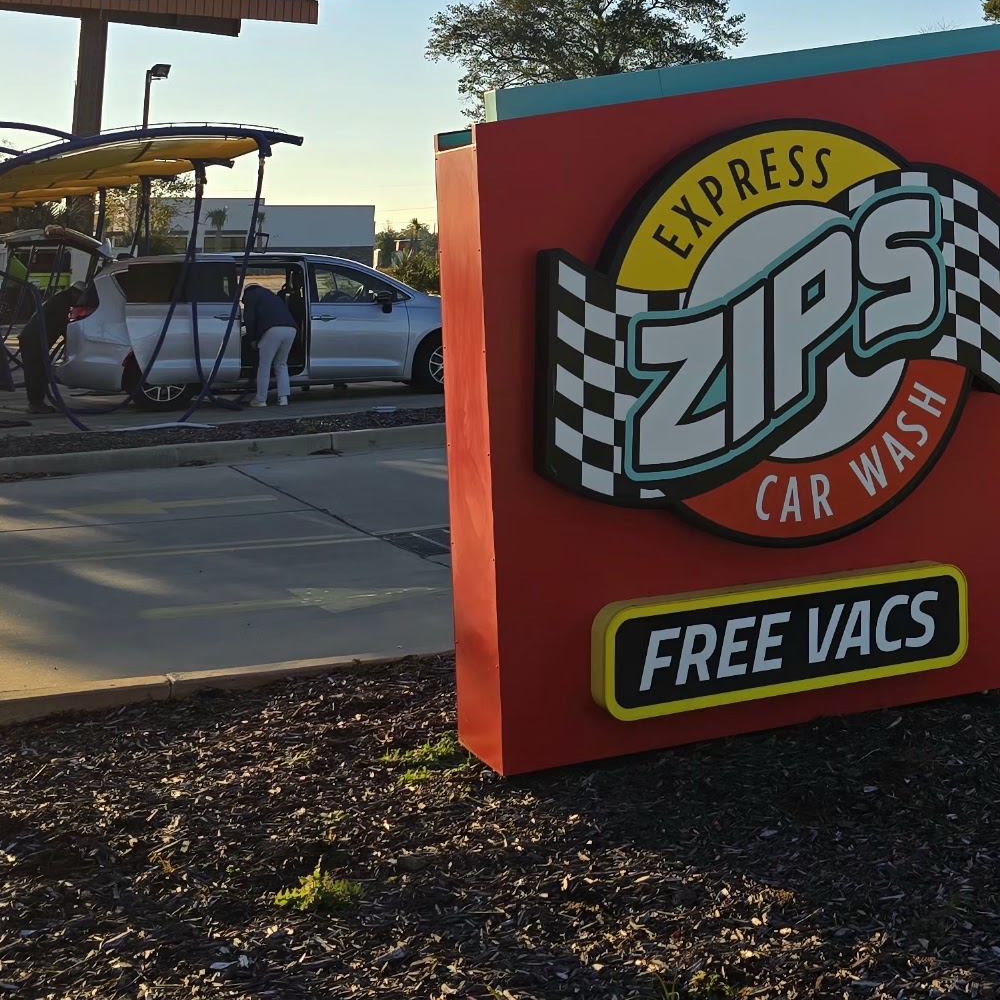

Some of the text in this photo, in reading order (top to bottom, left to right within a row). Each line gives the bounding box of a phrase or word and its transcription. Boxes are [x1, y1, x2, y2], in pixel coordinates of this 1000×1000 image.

[652, 144, 832, 260] EXPRESS
[636, 197, 936, 468] ZIPS
[755, 381, 947, 524] CAR WASH
[638, 590, 940, 692] FREE VACS
